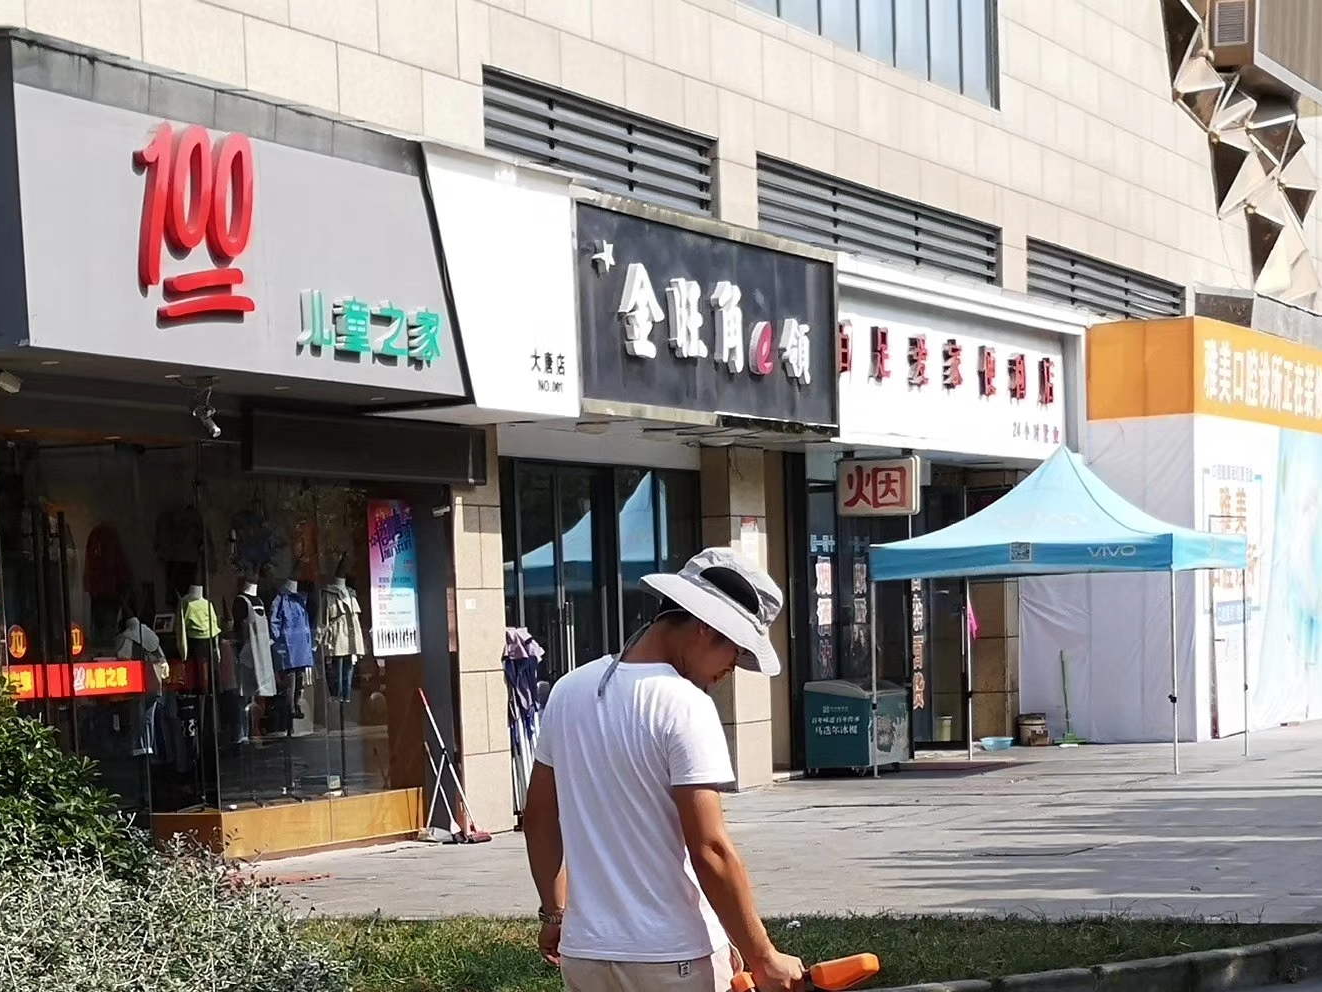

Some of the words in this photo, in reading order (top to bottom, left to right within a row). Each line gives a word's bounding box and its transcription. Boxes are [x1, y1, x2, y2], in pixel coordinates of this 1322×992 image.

[135, 120, 254, 286] 100
[297, 289, 440, 362] 儿童之家
[530, 350, 566, 375] 大唐店
[537, 380, 564, 393] NO.001
[1012, 421, 1060, 444] 24小时营业
[843, 465, 907, 508] 烟
